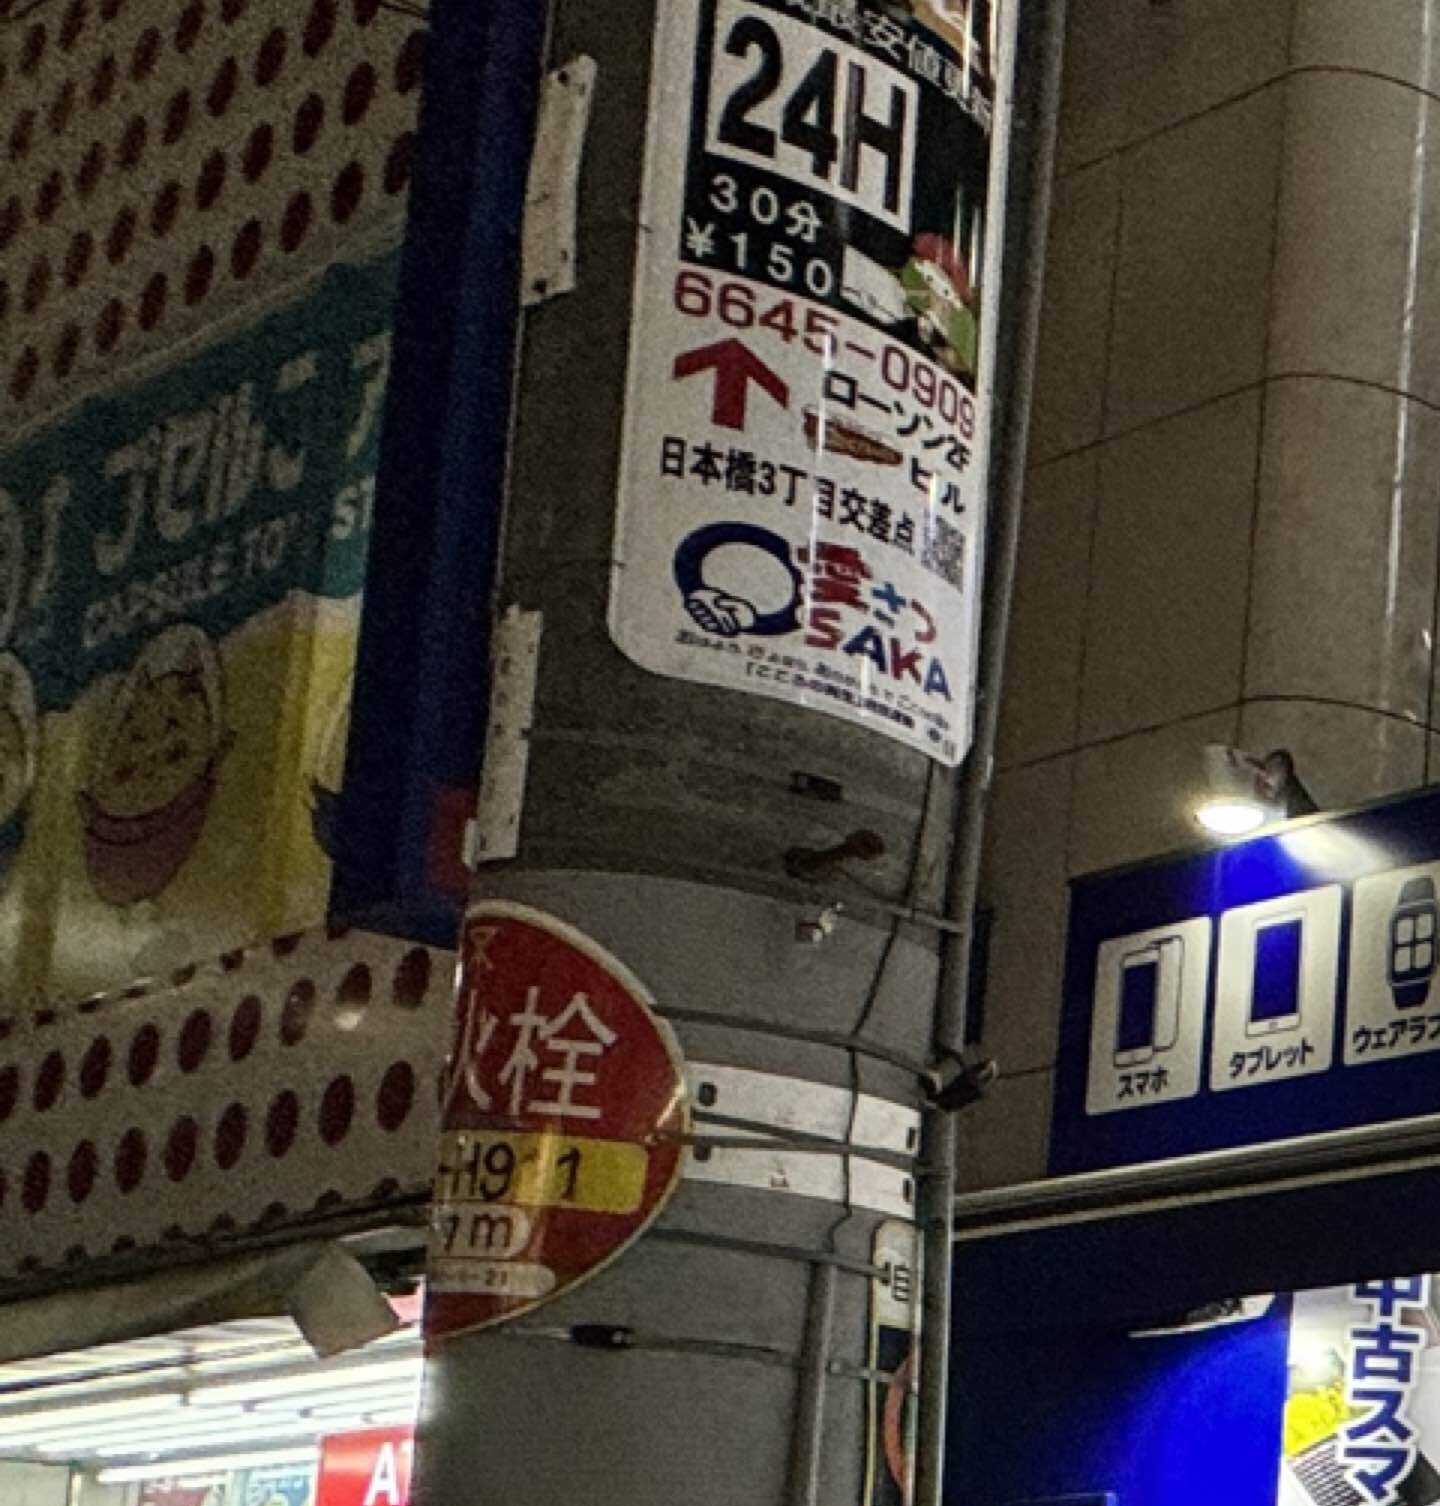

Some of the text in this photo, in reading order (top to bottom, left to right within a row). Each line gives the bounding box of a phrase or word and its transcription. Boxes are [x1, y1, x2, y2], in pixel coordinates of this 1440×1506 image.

[716, 16, 908, 216] 24H
[708, 174, 824, 243] 30分
[685, 217, 834, 296] ¥150
[673, 271, 975, 441] 6645-0909
[659, 436, 916, 556] 日本橋3丁目交差点
[1117, 1065, 1169, 1098] スマホ
[1228, 1038, 1316, 1079] タブレット
